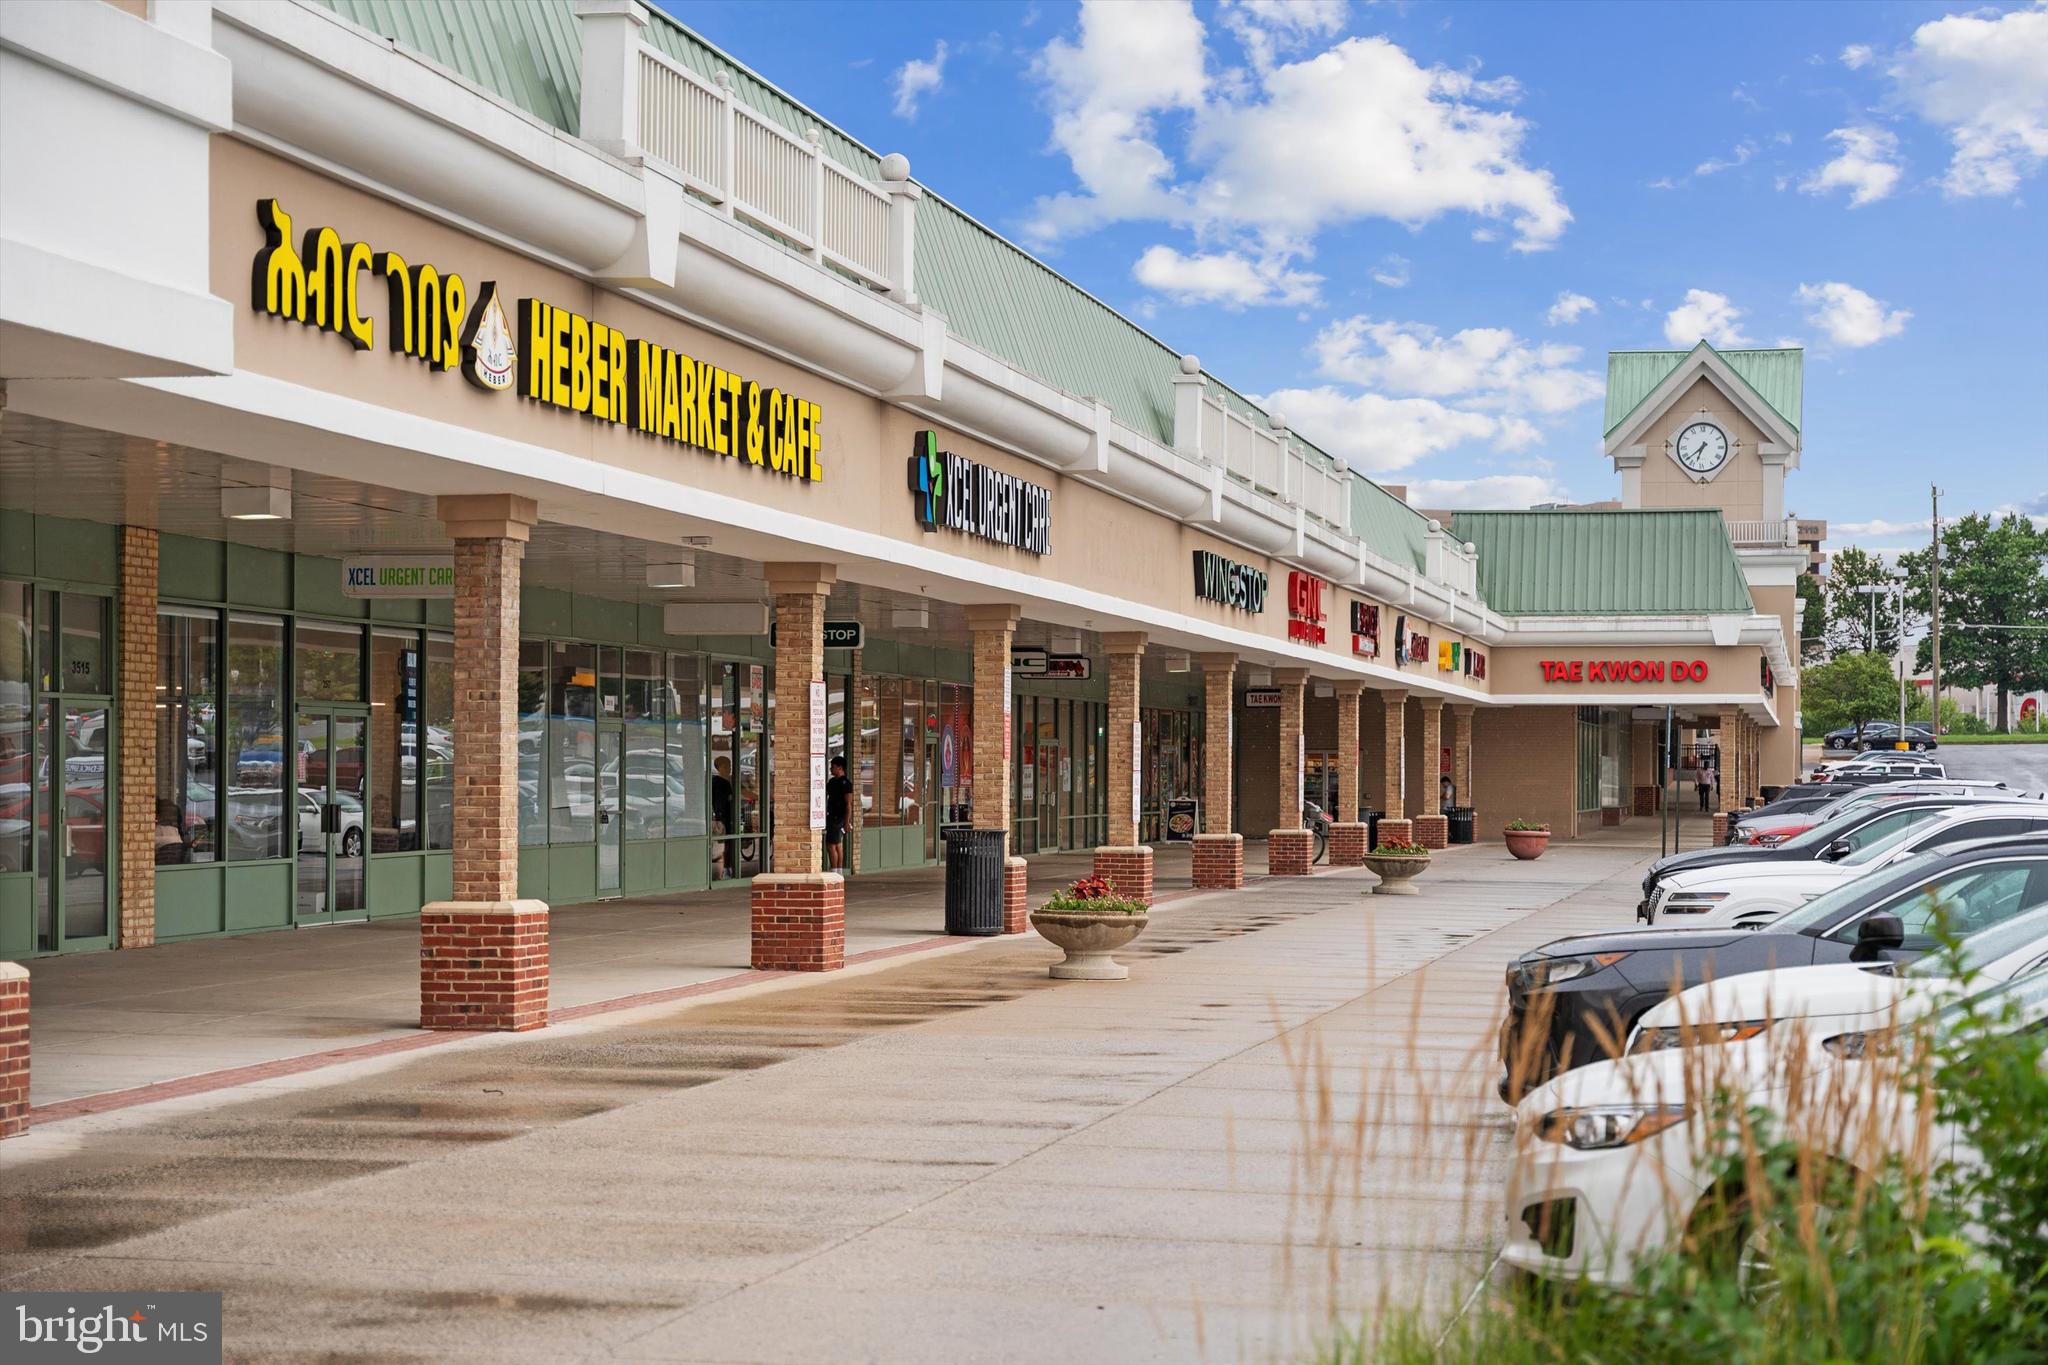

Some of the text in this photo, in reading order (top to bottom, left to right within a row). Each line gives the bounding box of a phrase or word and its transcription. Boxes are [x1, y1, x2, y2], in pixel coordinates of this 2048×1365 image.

[483, 368, 507, 385] HEBER
[525, 298, 823, 483] HEBER MARKET & CAFE
[944, 451, 1052, 556] XCEL URGENT CARE
[347, 567, 455, 587] XCEL URGENT CAR
[1293, 571, 1328, 622] GNC
[71, 661, 90, 675] 3515
[1539, 660, 1709, 682] TAE KWON DO
[1250, 694, 1263, 704] TAE
